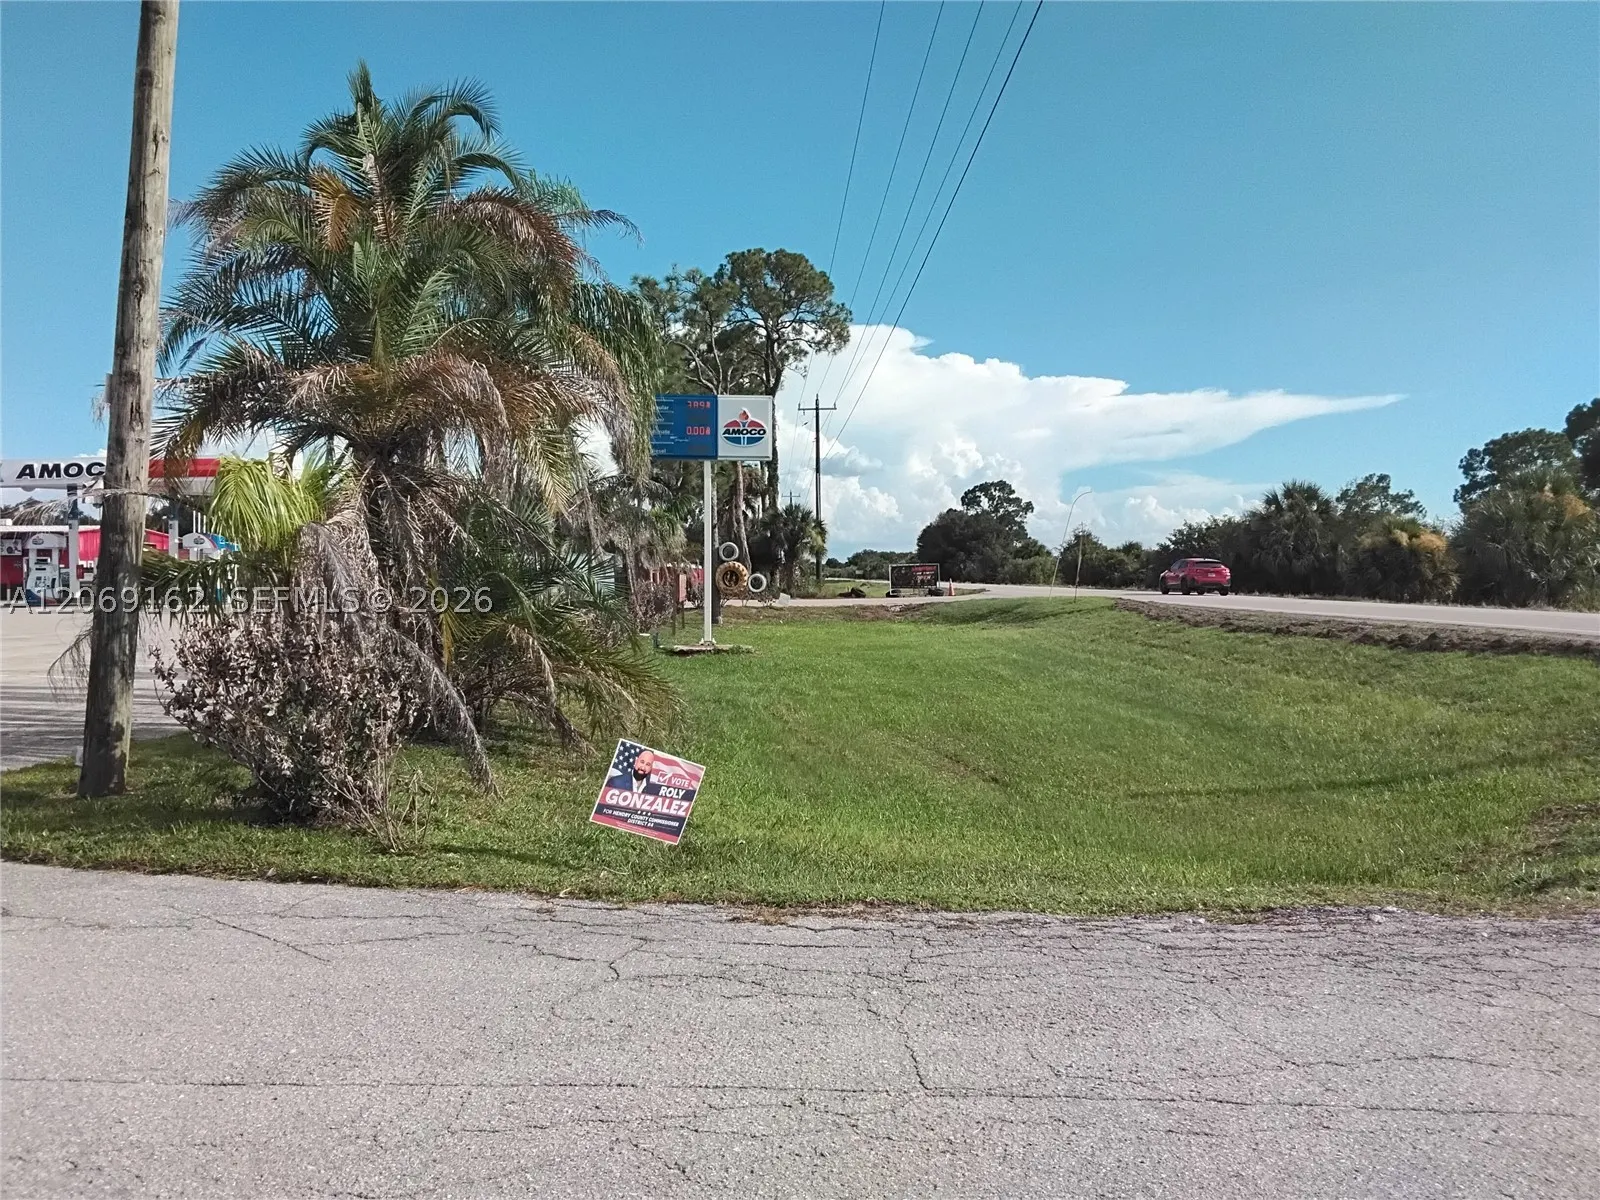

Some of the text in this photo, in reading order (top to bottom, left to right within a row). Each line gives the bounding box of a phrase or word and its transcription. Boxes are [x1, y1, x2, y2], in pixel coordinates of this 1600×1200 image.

[722, 428, 767, 436] AMOCO
[16, 462, 105, 479] AMOC
[671, 777, 690, 788] VOTE
[659, 786, 686, 799] ROLY
[605, 789, 690, 816] GONZALEZ
[627, 818, 648, 827] DISTRICT
[631, 813, 649, 821] COUNTY
